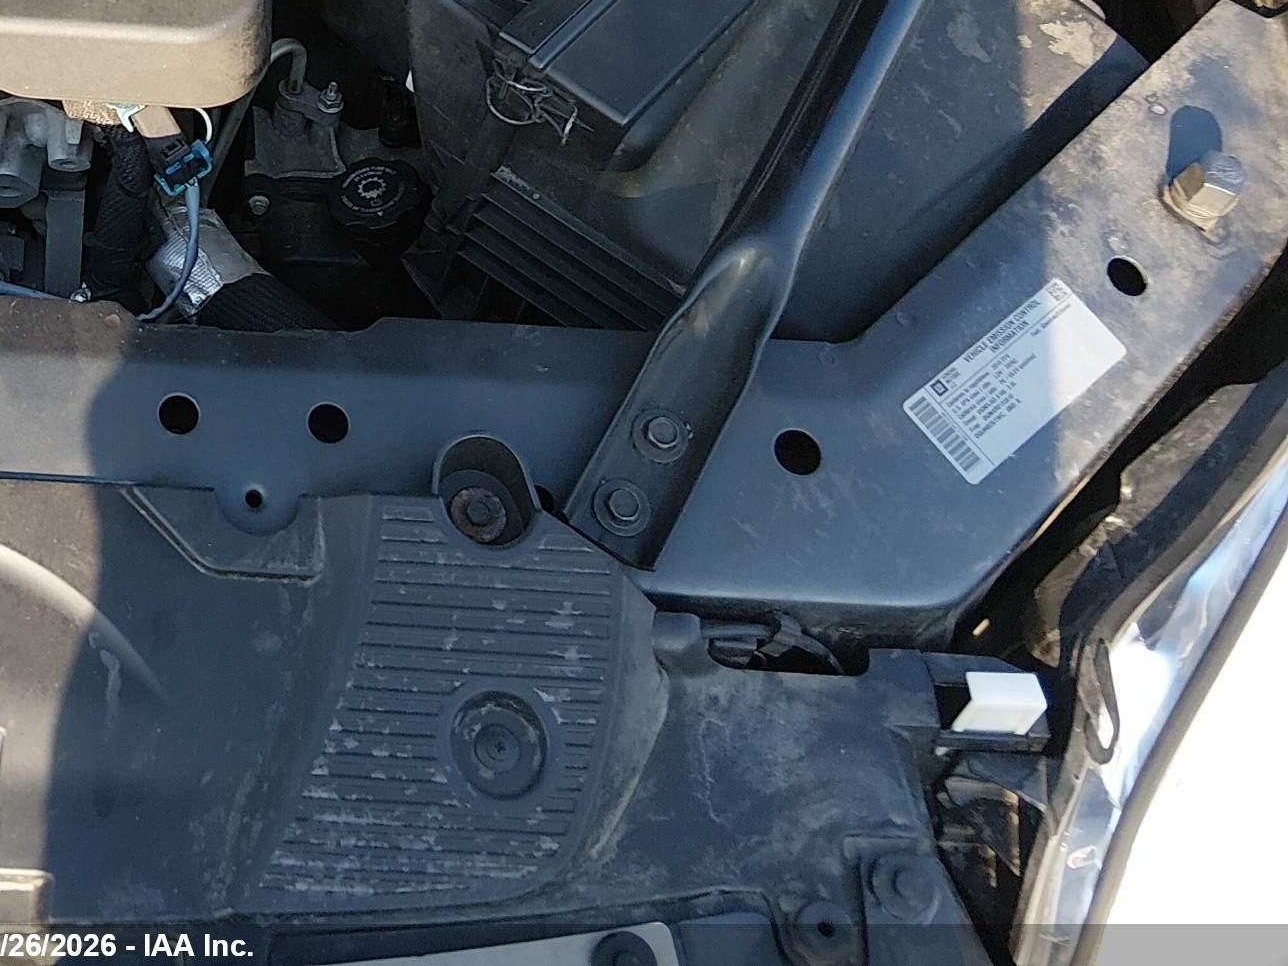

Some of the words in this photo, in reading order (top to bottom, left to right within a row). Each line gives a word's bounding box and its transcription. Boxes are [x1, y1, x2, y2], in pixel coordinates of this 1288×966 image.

[964, 342, 986, 362] VEHICLE
[987, 319, 1014, 343] EMISSION
[1013, 299, 1039, 321] CONTROL
[990, 319, 1028, 353] INFORMATION
